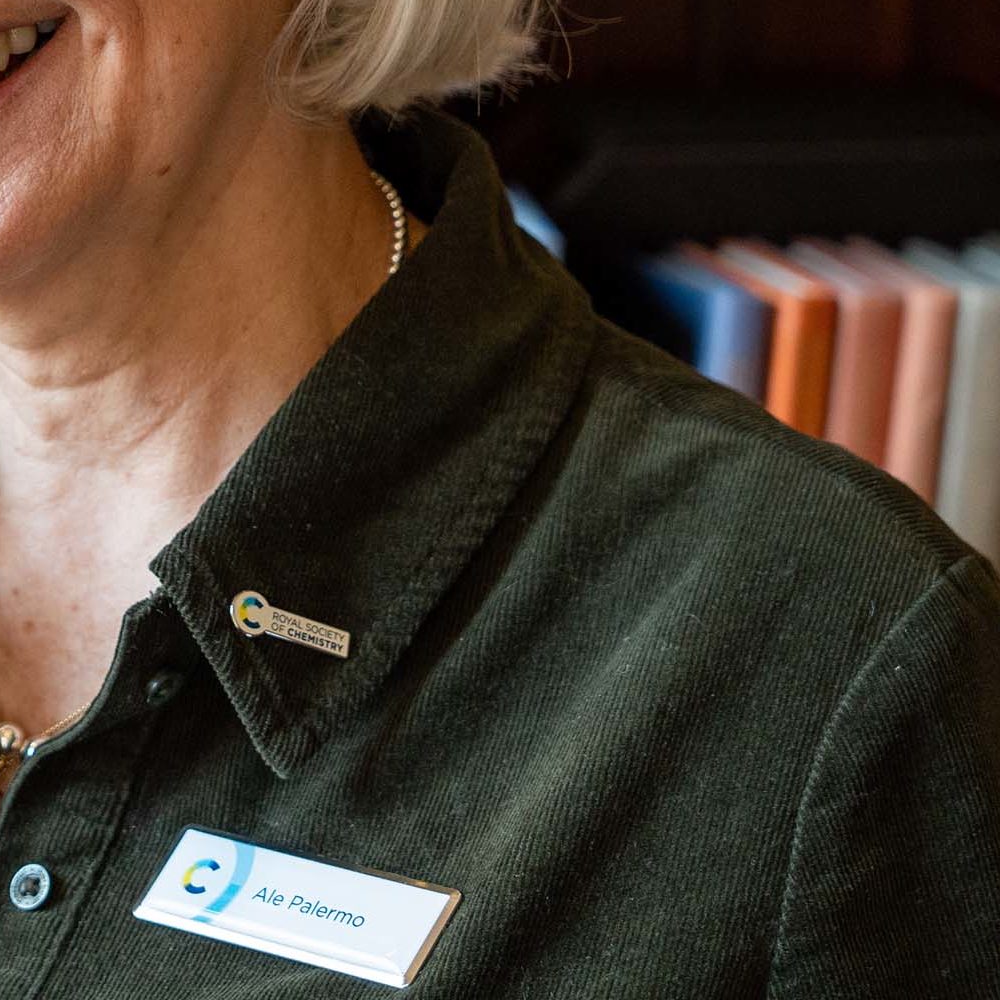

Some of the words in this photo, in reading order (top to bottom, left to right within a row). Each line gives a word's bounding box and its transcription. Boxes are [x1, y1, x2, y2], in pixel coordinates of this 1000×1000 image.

[270, 622, 286, 632] OF
[287, 627, 344, 652] CHEMISTRY
[272, 611, 303, 630] ROYAL
[305, 622, 346, 641] SOCIETY
[251, 887, 285, 906] Ale
[287, 895, 366, 928] Palermo
